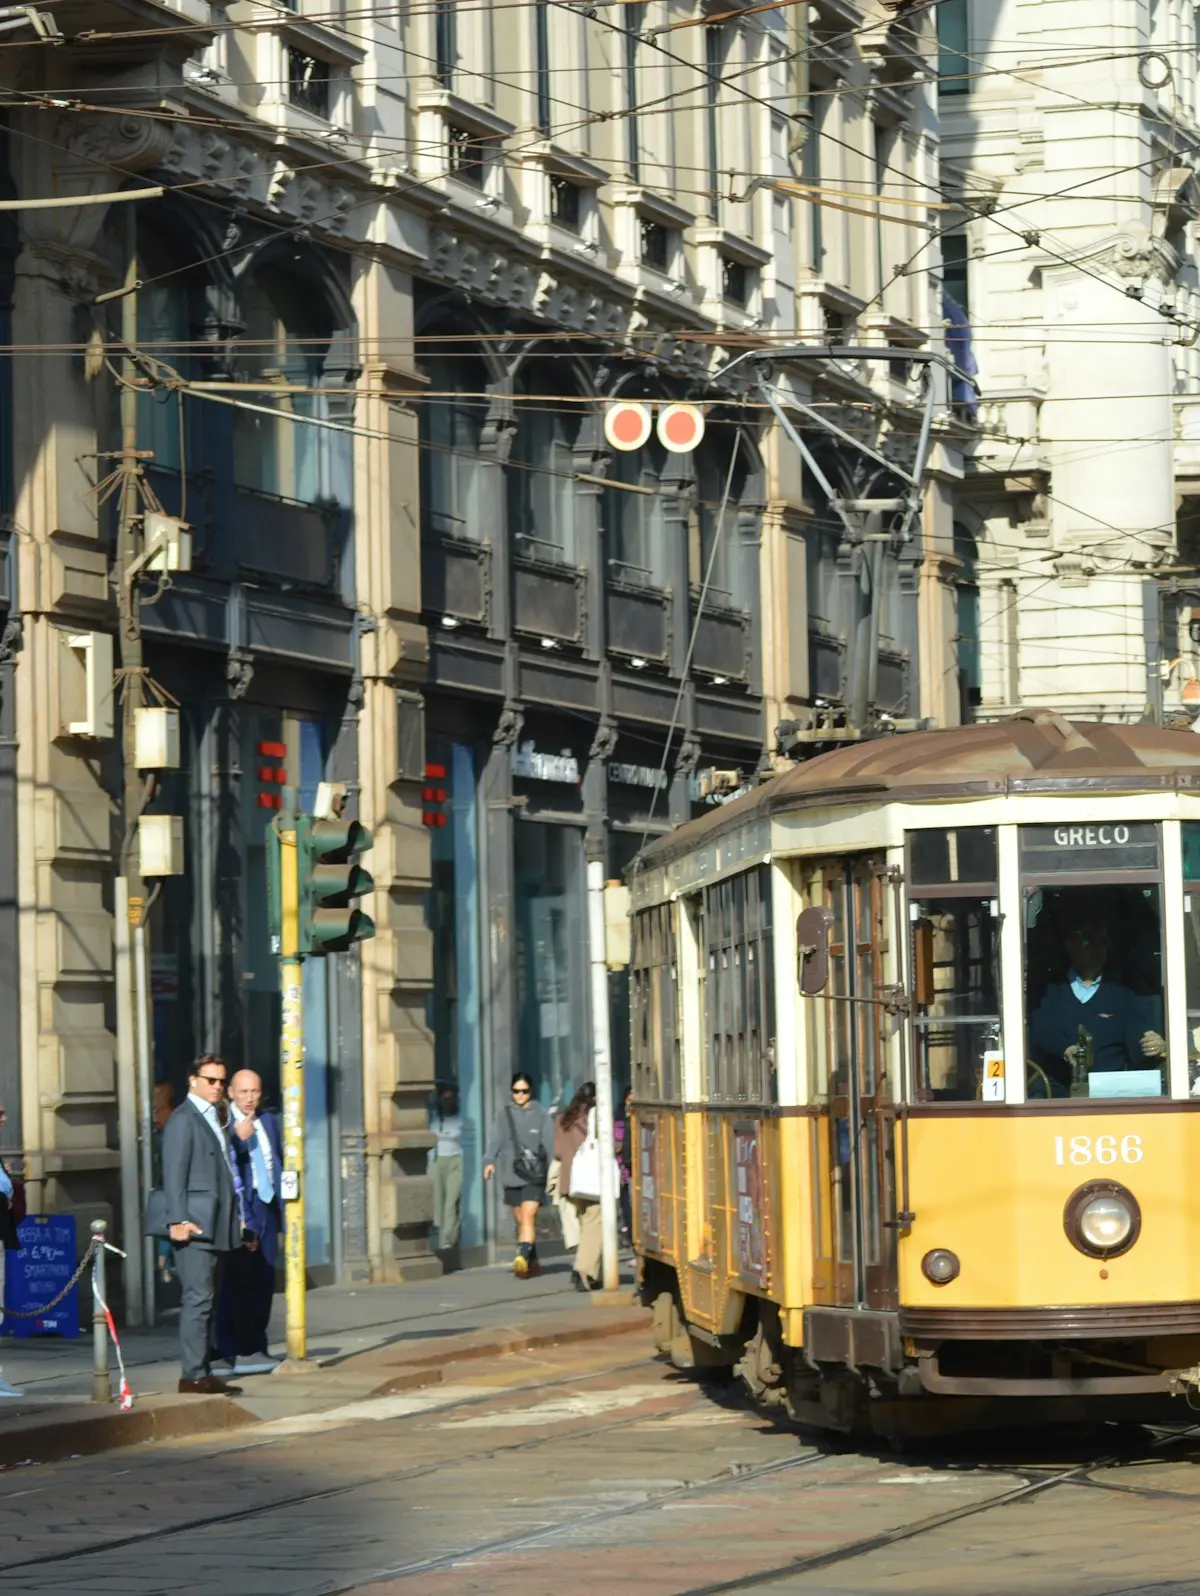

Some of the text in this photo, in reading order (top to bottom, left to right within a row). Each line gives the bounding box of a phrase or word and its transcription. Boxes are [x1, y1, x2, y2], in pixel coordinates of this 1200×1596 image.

[1053, 823, 1130, 846] GRECO
[991, 1060, 1001, 1078] 2
[1053, 1133, 1145, 1167] 1866
